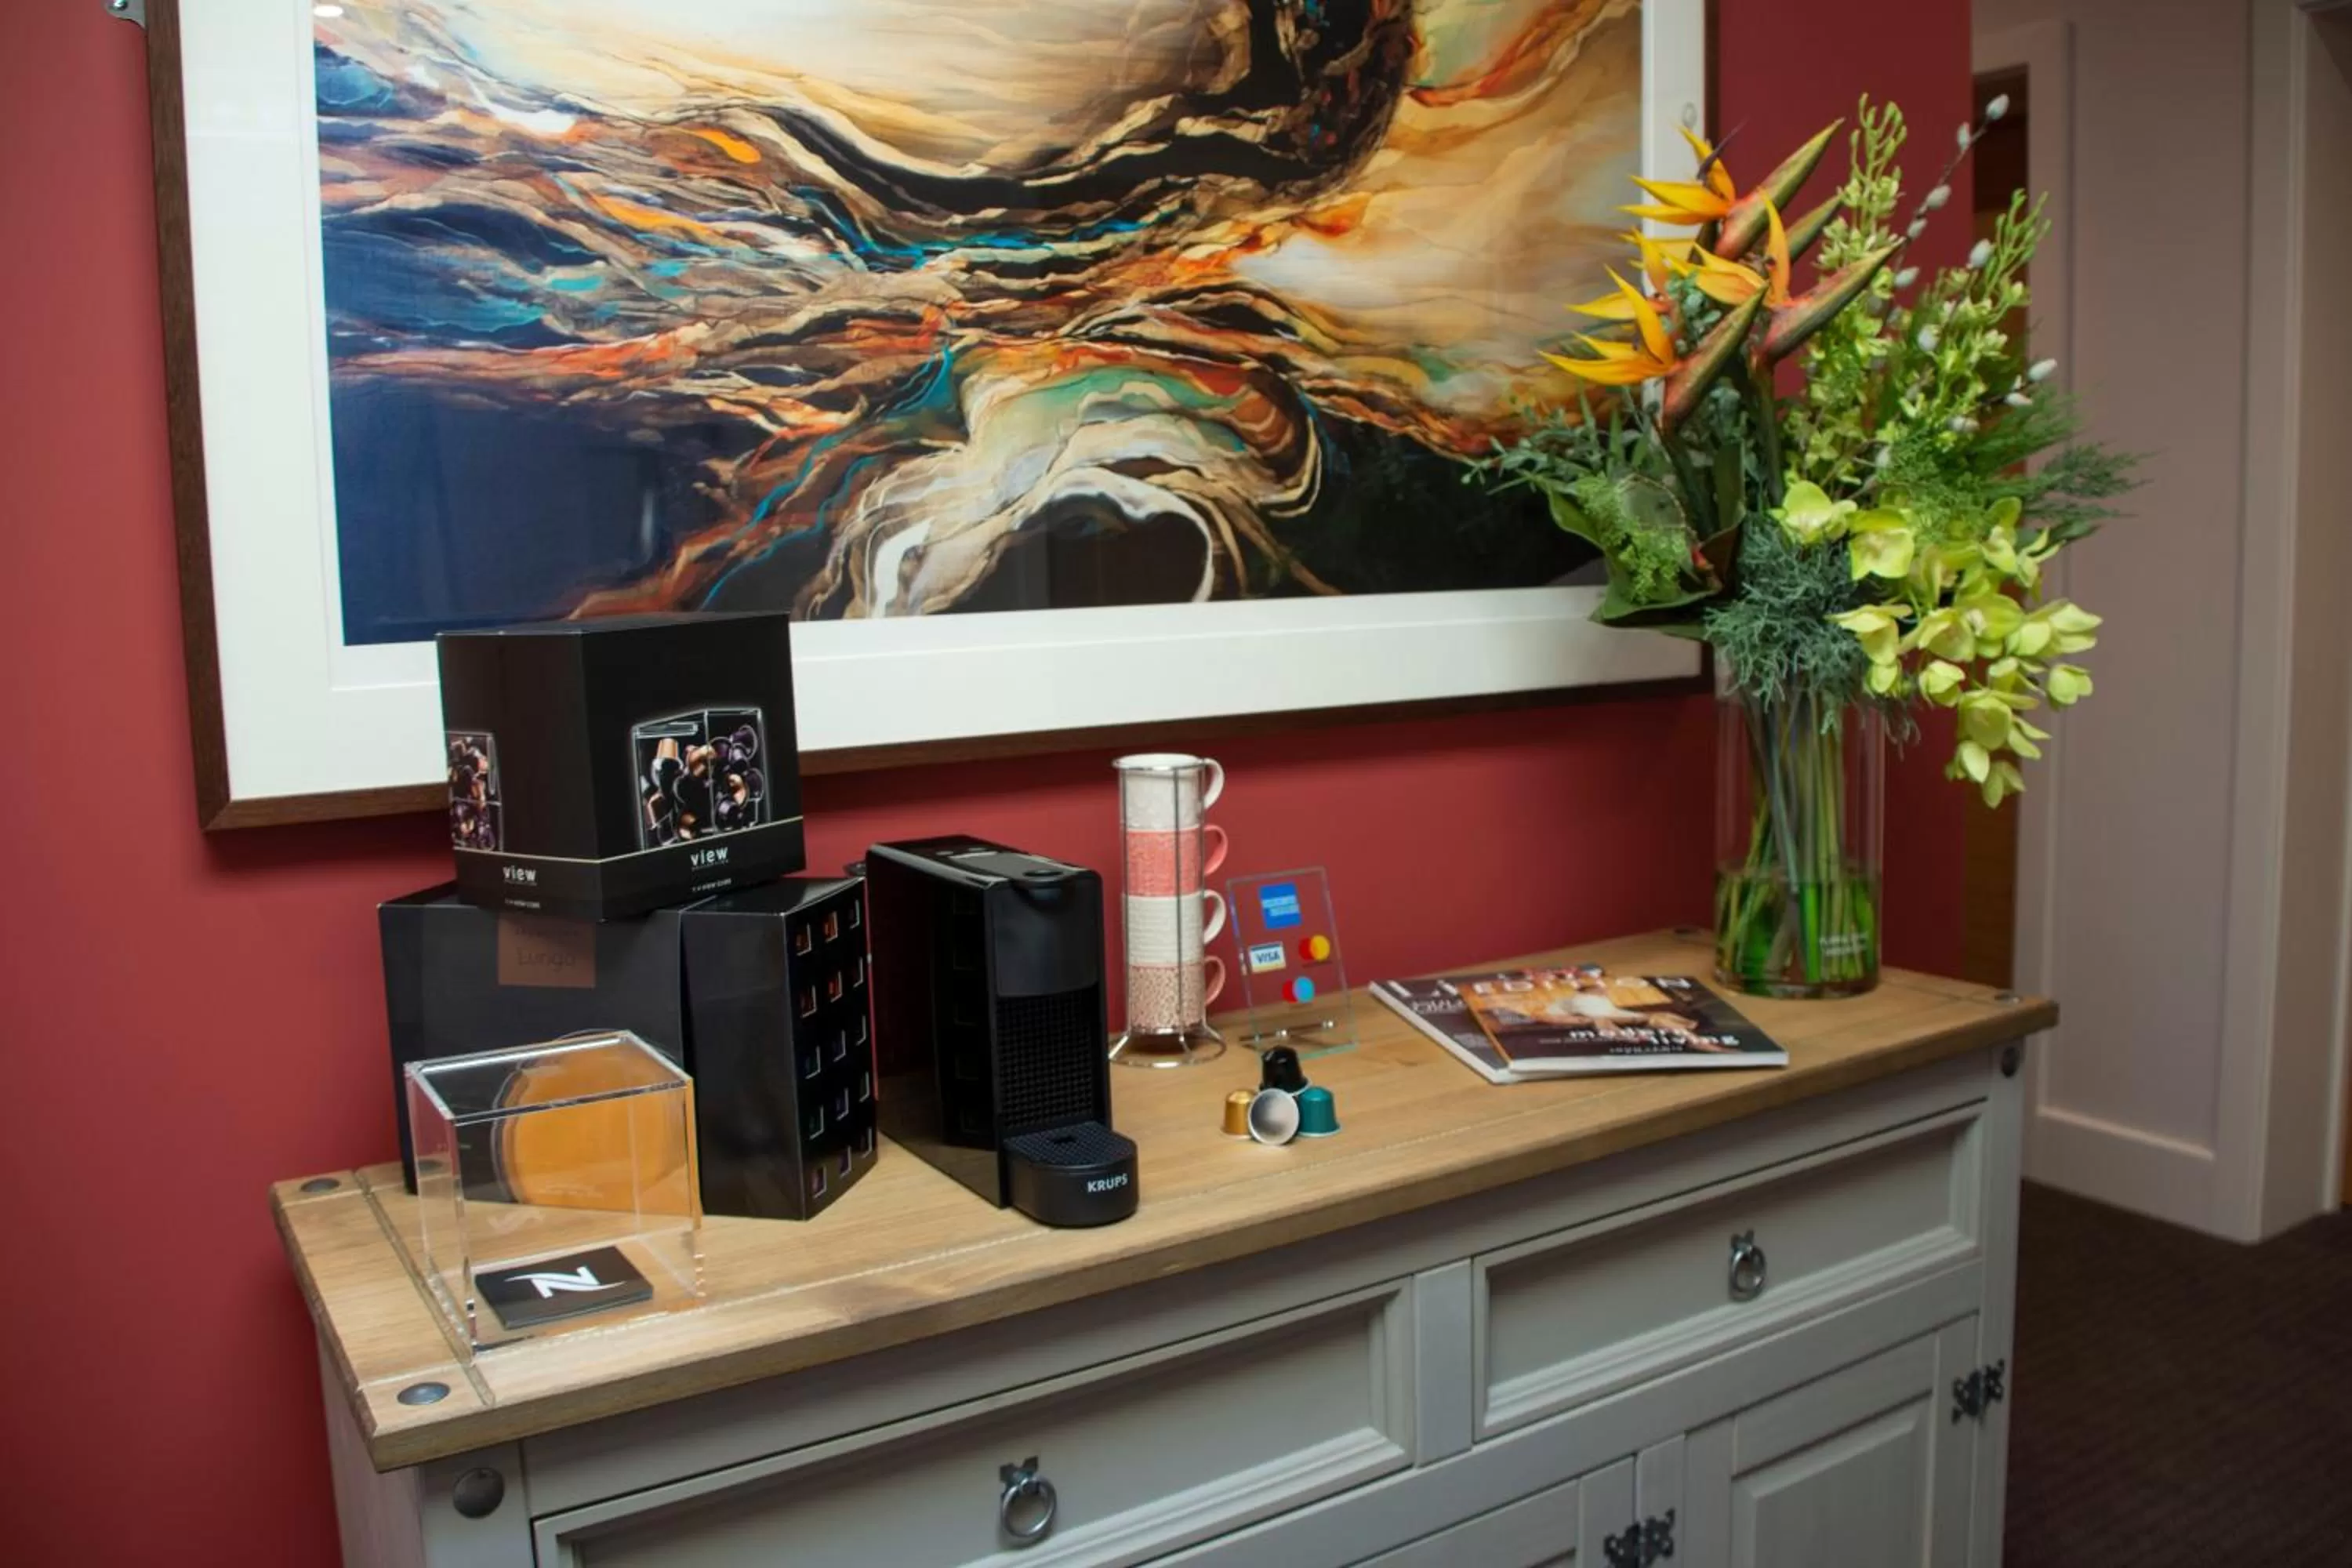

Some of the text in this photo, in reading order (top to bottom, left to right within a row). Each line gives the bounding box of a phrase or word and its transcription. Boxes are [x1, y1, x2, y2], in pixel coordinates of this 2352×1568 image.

[691, 847, 728, 866] view
[503, 865, 536, 882] view
[1256, 950, 1279, 964] VISA
[1087, 1172, 1128, 1193] KRUPS
